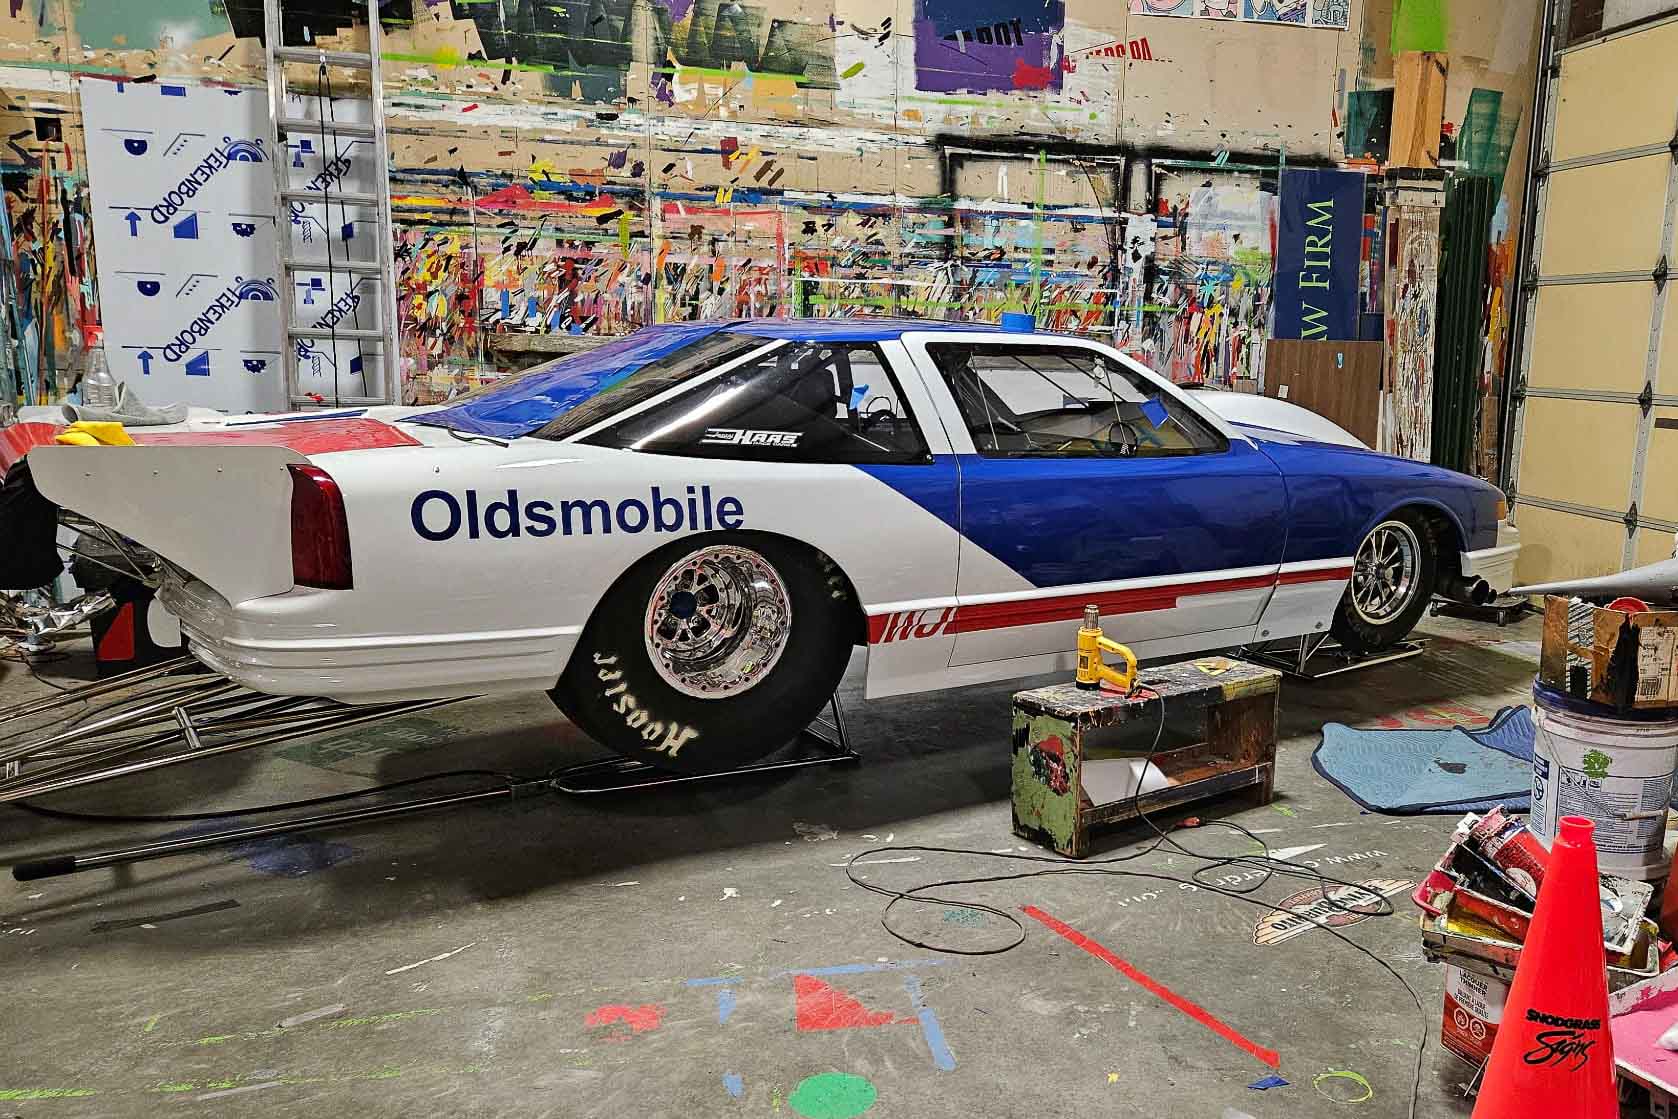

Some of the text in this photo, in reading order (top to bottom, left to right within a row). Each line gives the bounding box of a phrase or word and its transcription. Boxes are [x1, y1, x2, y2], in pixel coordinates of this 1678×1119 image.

[150, 146, 231, 224] TEKENBORD
[1299, 197, 1334, 341] W FIRM
[163, 287, 243, 362] TEKENBORD
[733, 430, 797, 445] HAAS
[411, 486, 744, 541] Oldsmobile
[1523, 1030, 1596, 1073] Signs
